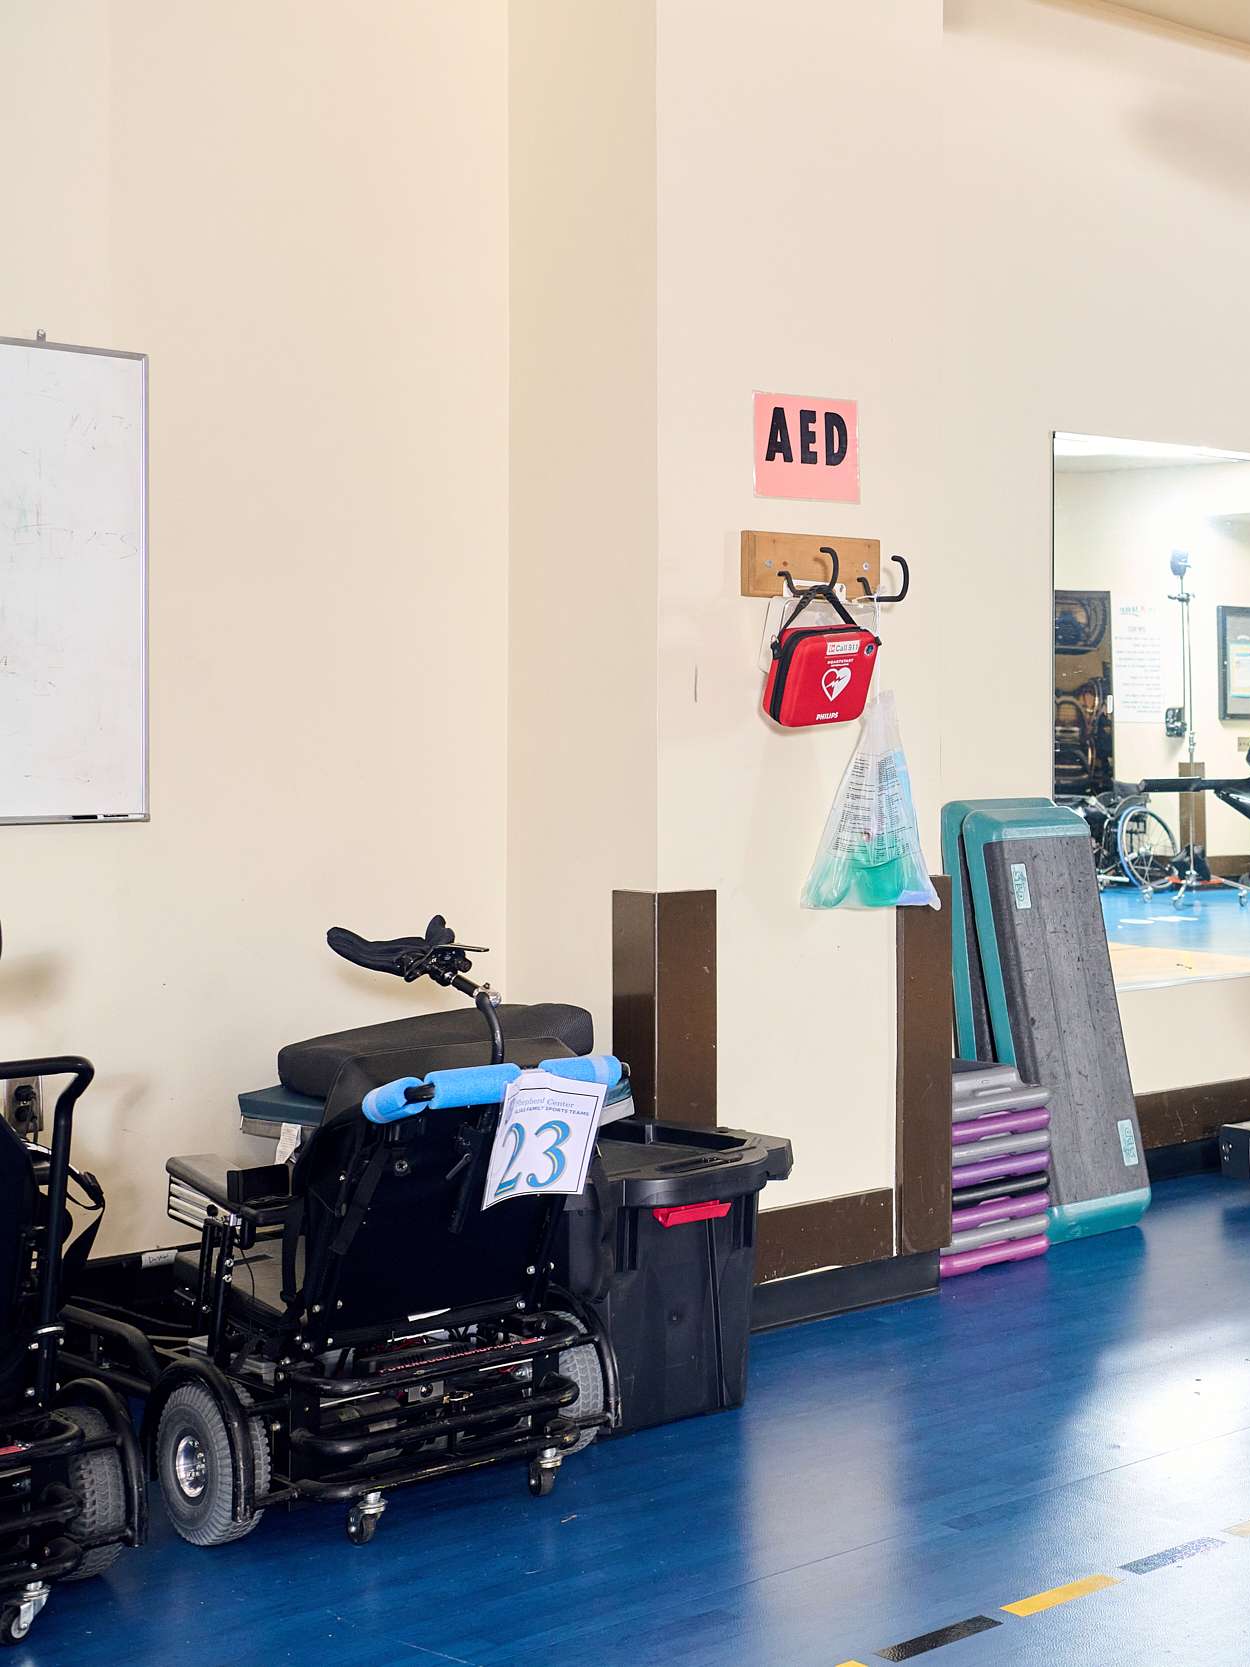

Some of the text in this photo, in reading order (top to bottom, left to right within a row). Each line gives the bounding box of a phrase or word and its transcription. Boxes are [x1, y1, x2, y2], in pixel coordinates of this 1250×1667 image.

[765, 407, 848, 466] AED
[816, 711, 839, 721] PHILIPS
[494, 1120, 571, 1197] 23
